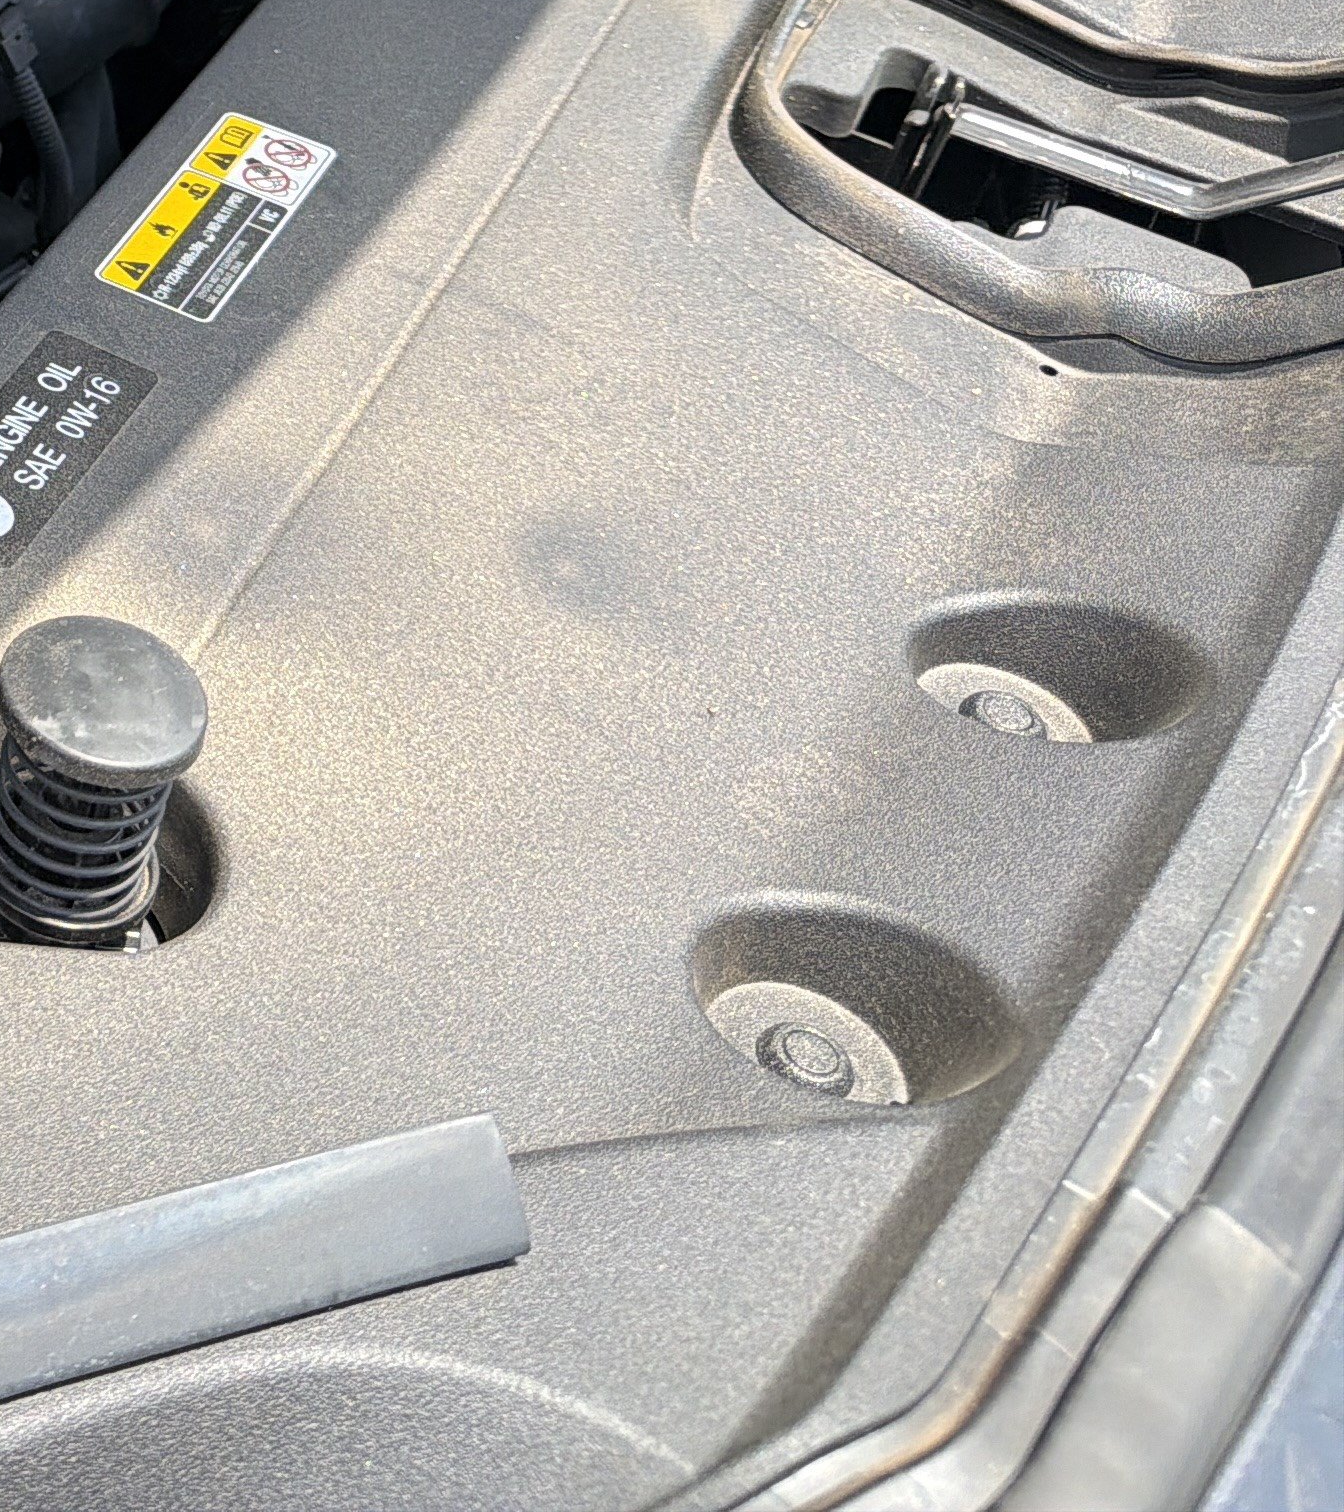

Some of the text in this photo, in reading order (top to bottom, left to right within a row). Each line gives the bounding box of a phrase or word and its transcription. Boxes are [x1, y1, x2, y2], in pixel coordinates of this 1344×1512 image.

[37, 361, 82, 392] OIL
[13, 374, 121, 491] SAE 0W-16
